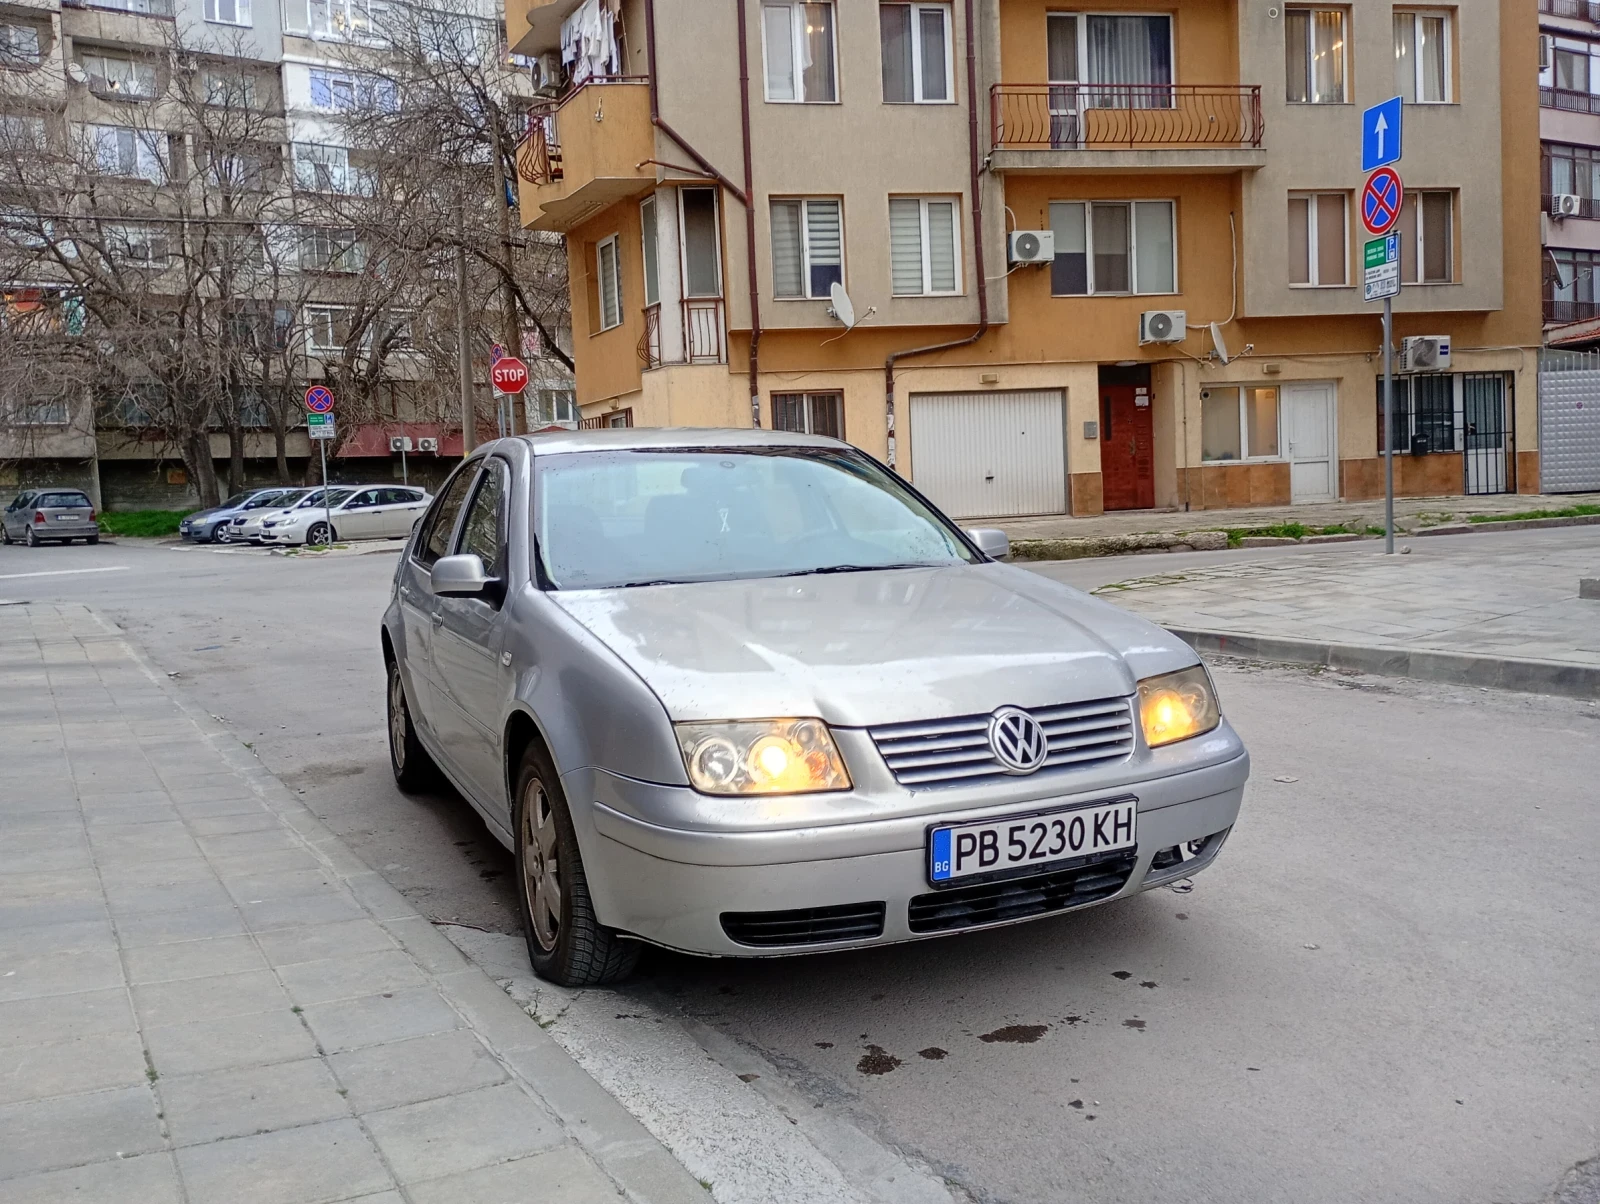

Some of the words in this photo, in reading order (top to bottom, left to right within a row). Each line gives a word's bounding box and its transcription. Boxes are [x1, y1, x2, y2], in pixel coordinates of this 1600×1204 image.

[1390, 238, 1394, 248] P
[494, 369, 525, 383] STOP
[955, 829, 1000, 871] PB
[1007, 816, 1085, 862] 5230
[1093, 807, 1133, 848] KH
[934, 861, 949, 873] BG
